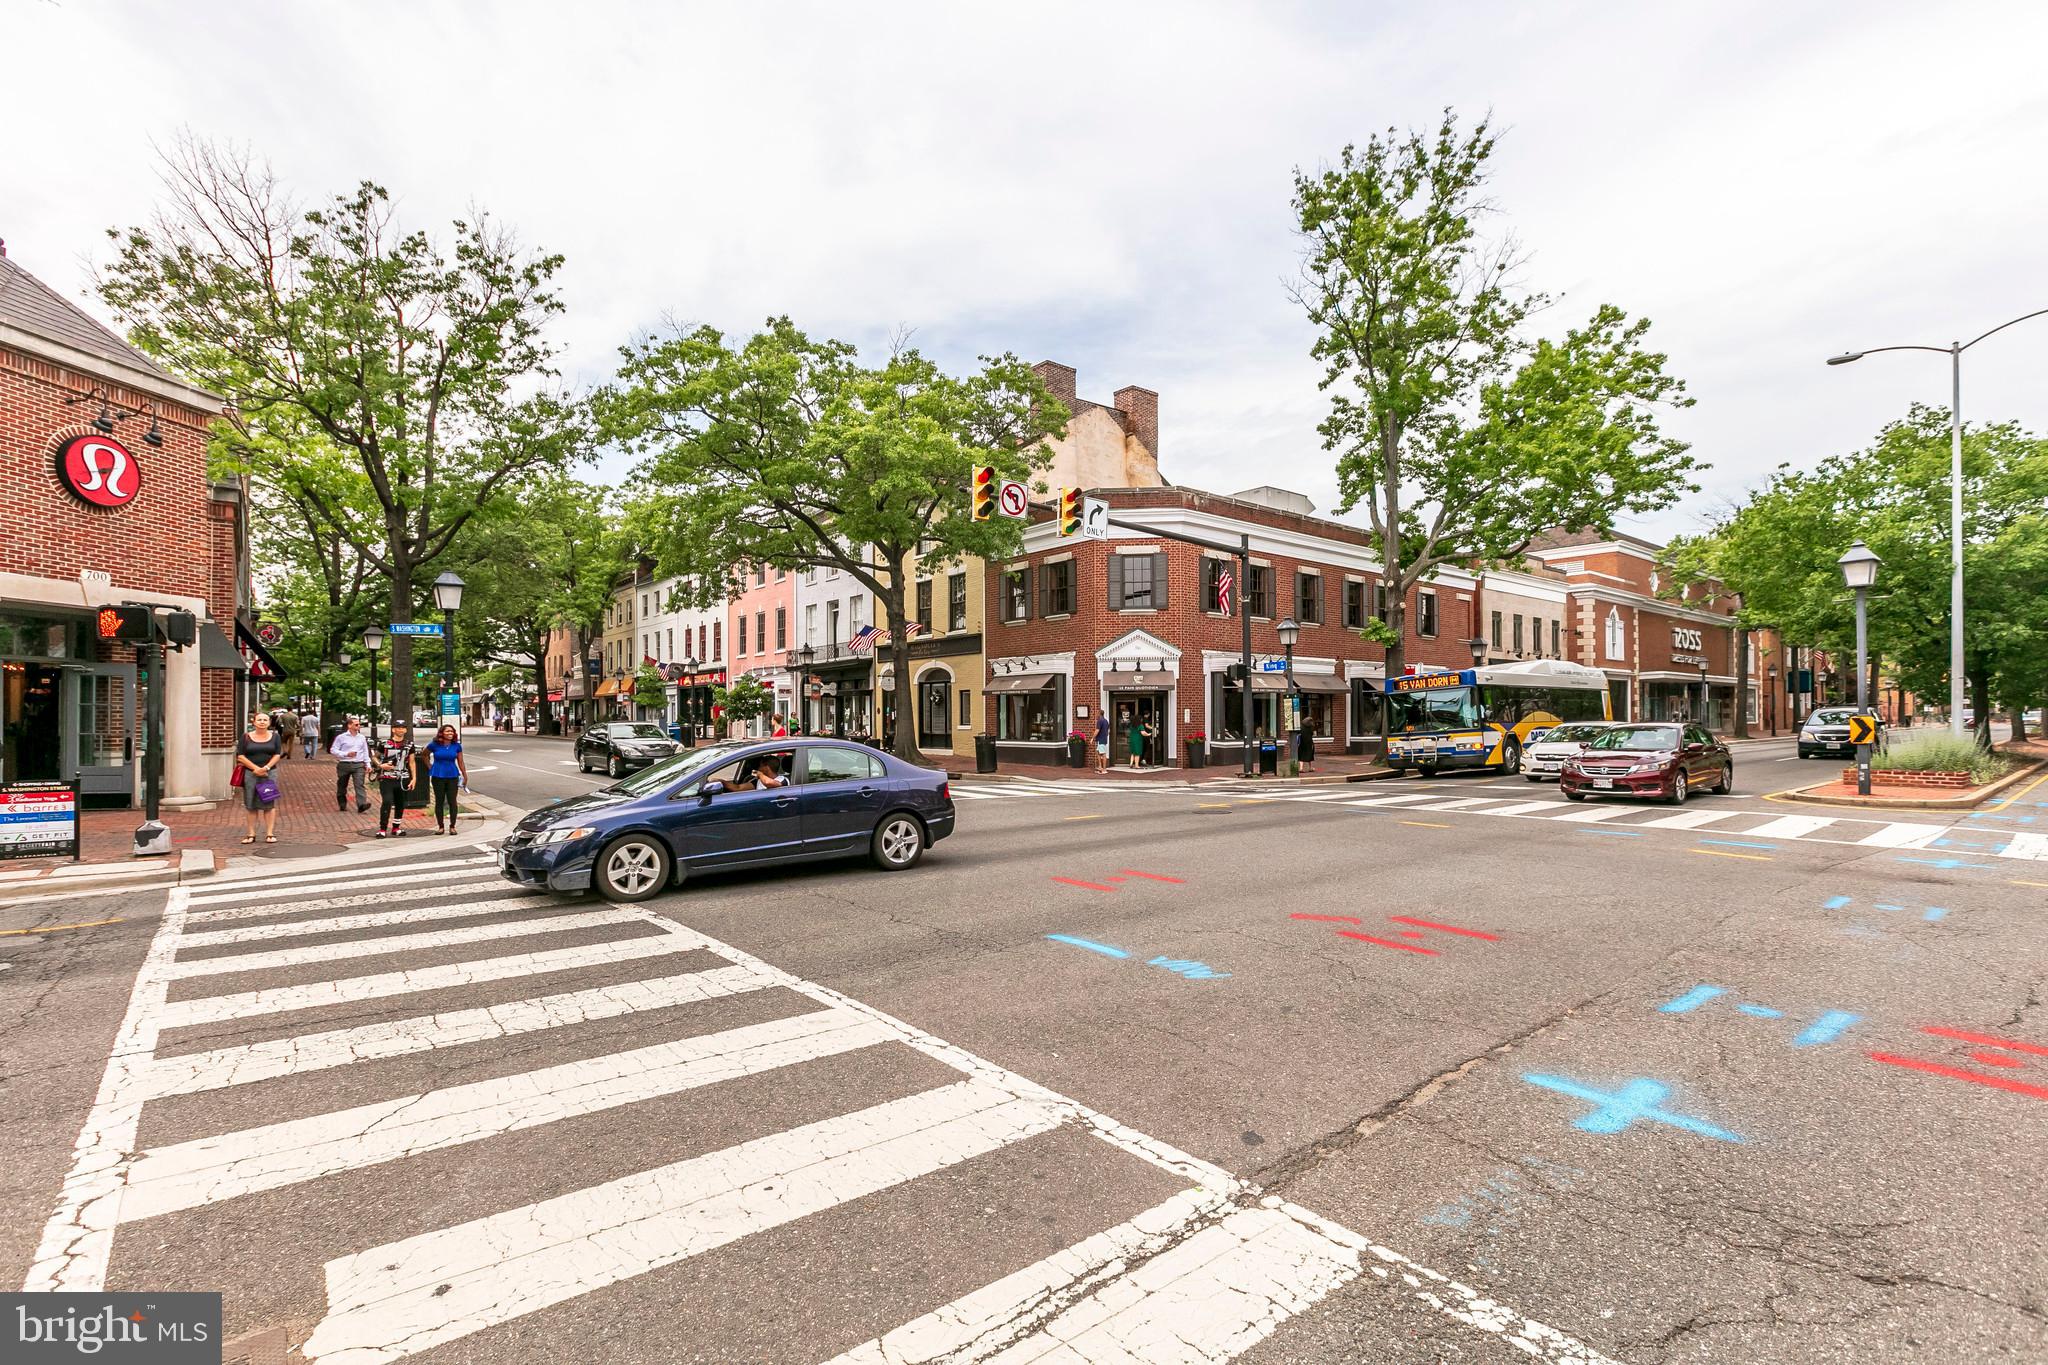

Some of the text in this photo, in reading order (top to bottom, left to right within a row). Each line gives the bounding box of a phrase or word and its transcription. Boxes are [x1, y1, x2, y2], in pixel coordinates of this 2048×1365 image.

[1086, 526, 1104, 536] ONLY
[87, 570, 107, 581] 700
[1672, 627, 1702, 651] ROSS
[1409, 679, 1426, 689] VAN
[1427, 676, 1449, 687] DORN
